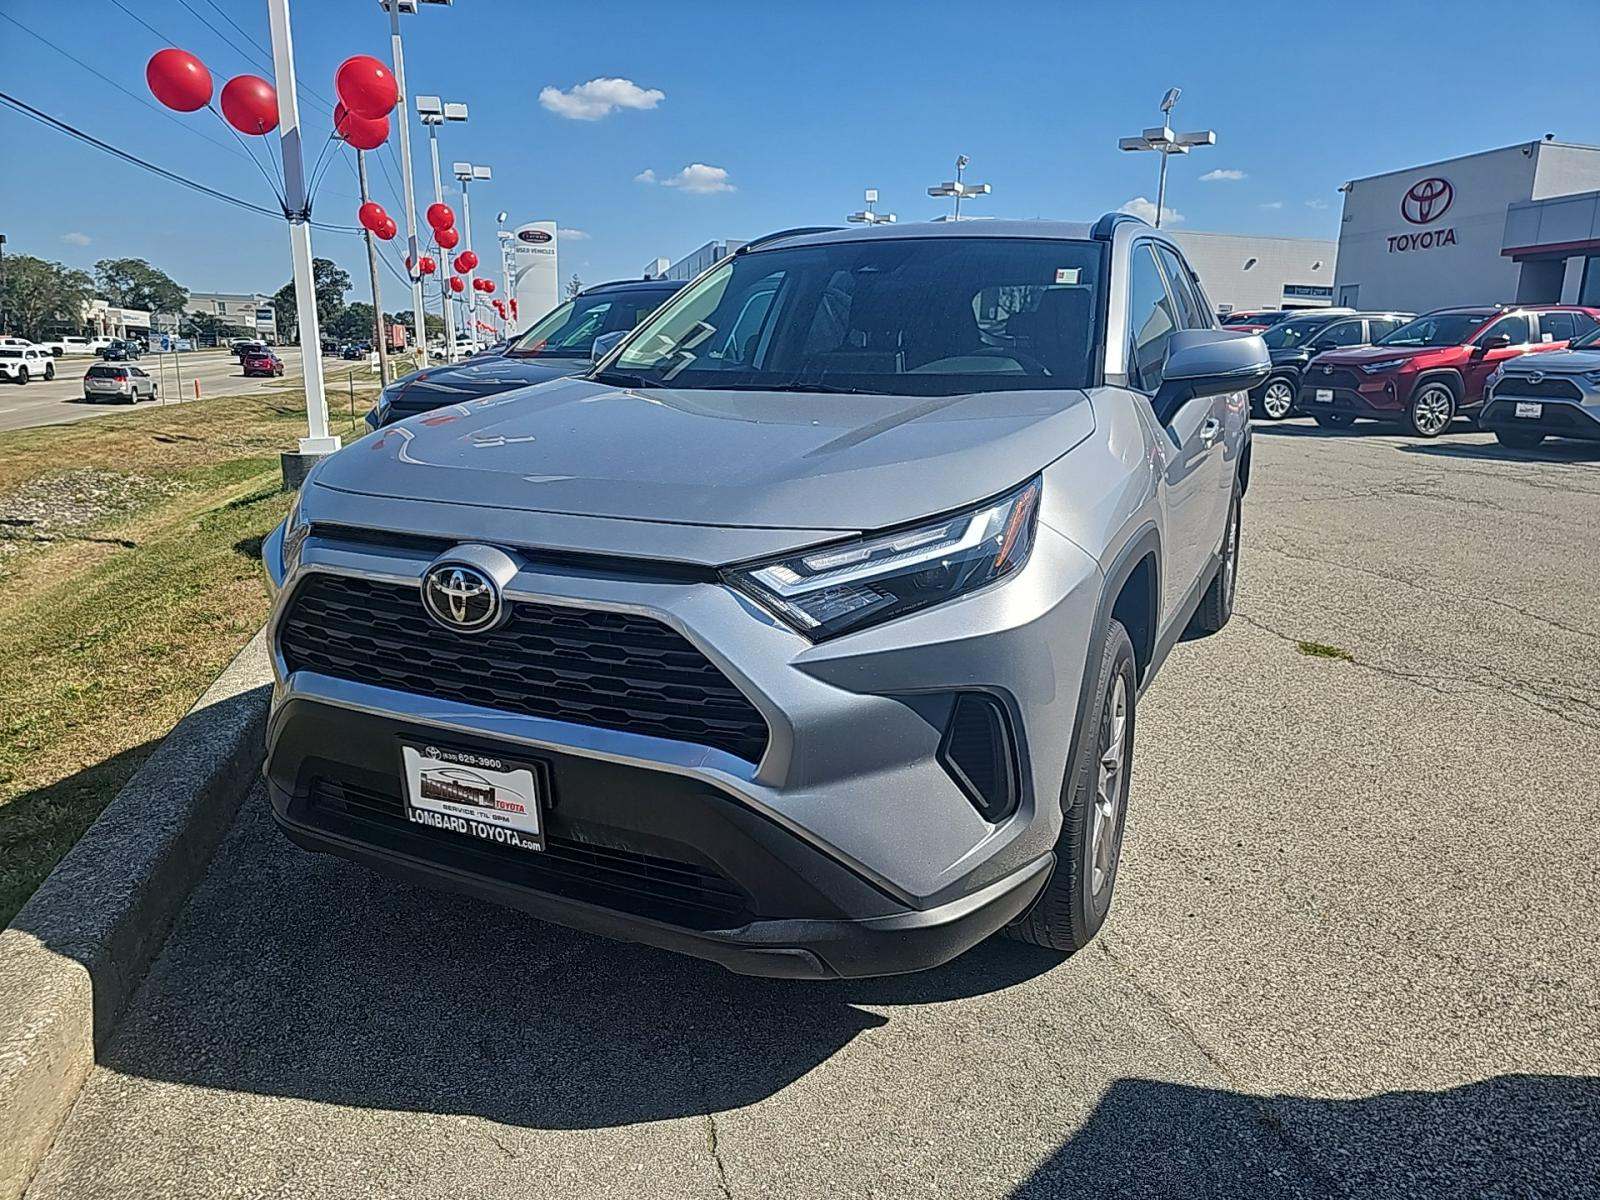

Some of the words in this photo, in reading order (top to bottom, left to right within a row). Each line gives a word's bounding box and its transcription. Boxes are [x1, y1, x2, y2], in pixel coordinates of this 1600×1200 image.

[1387, 228, 1456, 253] TOYOTA
[458, 753, 502, 769] 629-3900
[442, 804, 475, 816] SERVICE
[495, 800, 525, 813] TOYOTA
[408, 807, 467, 833] LOMBARD
